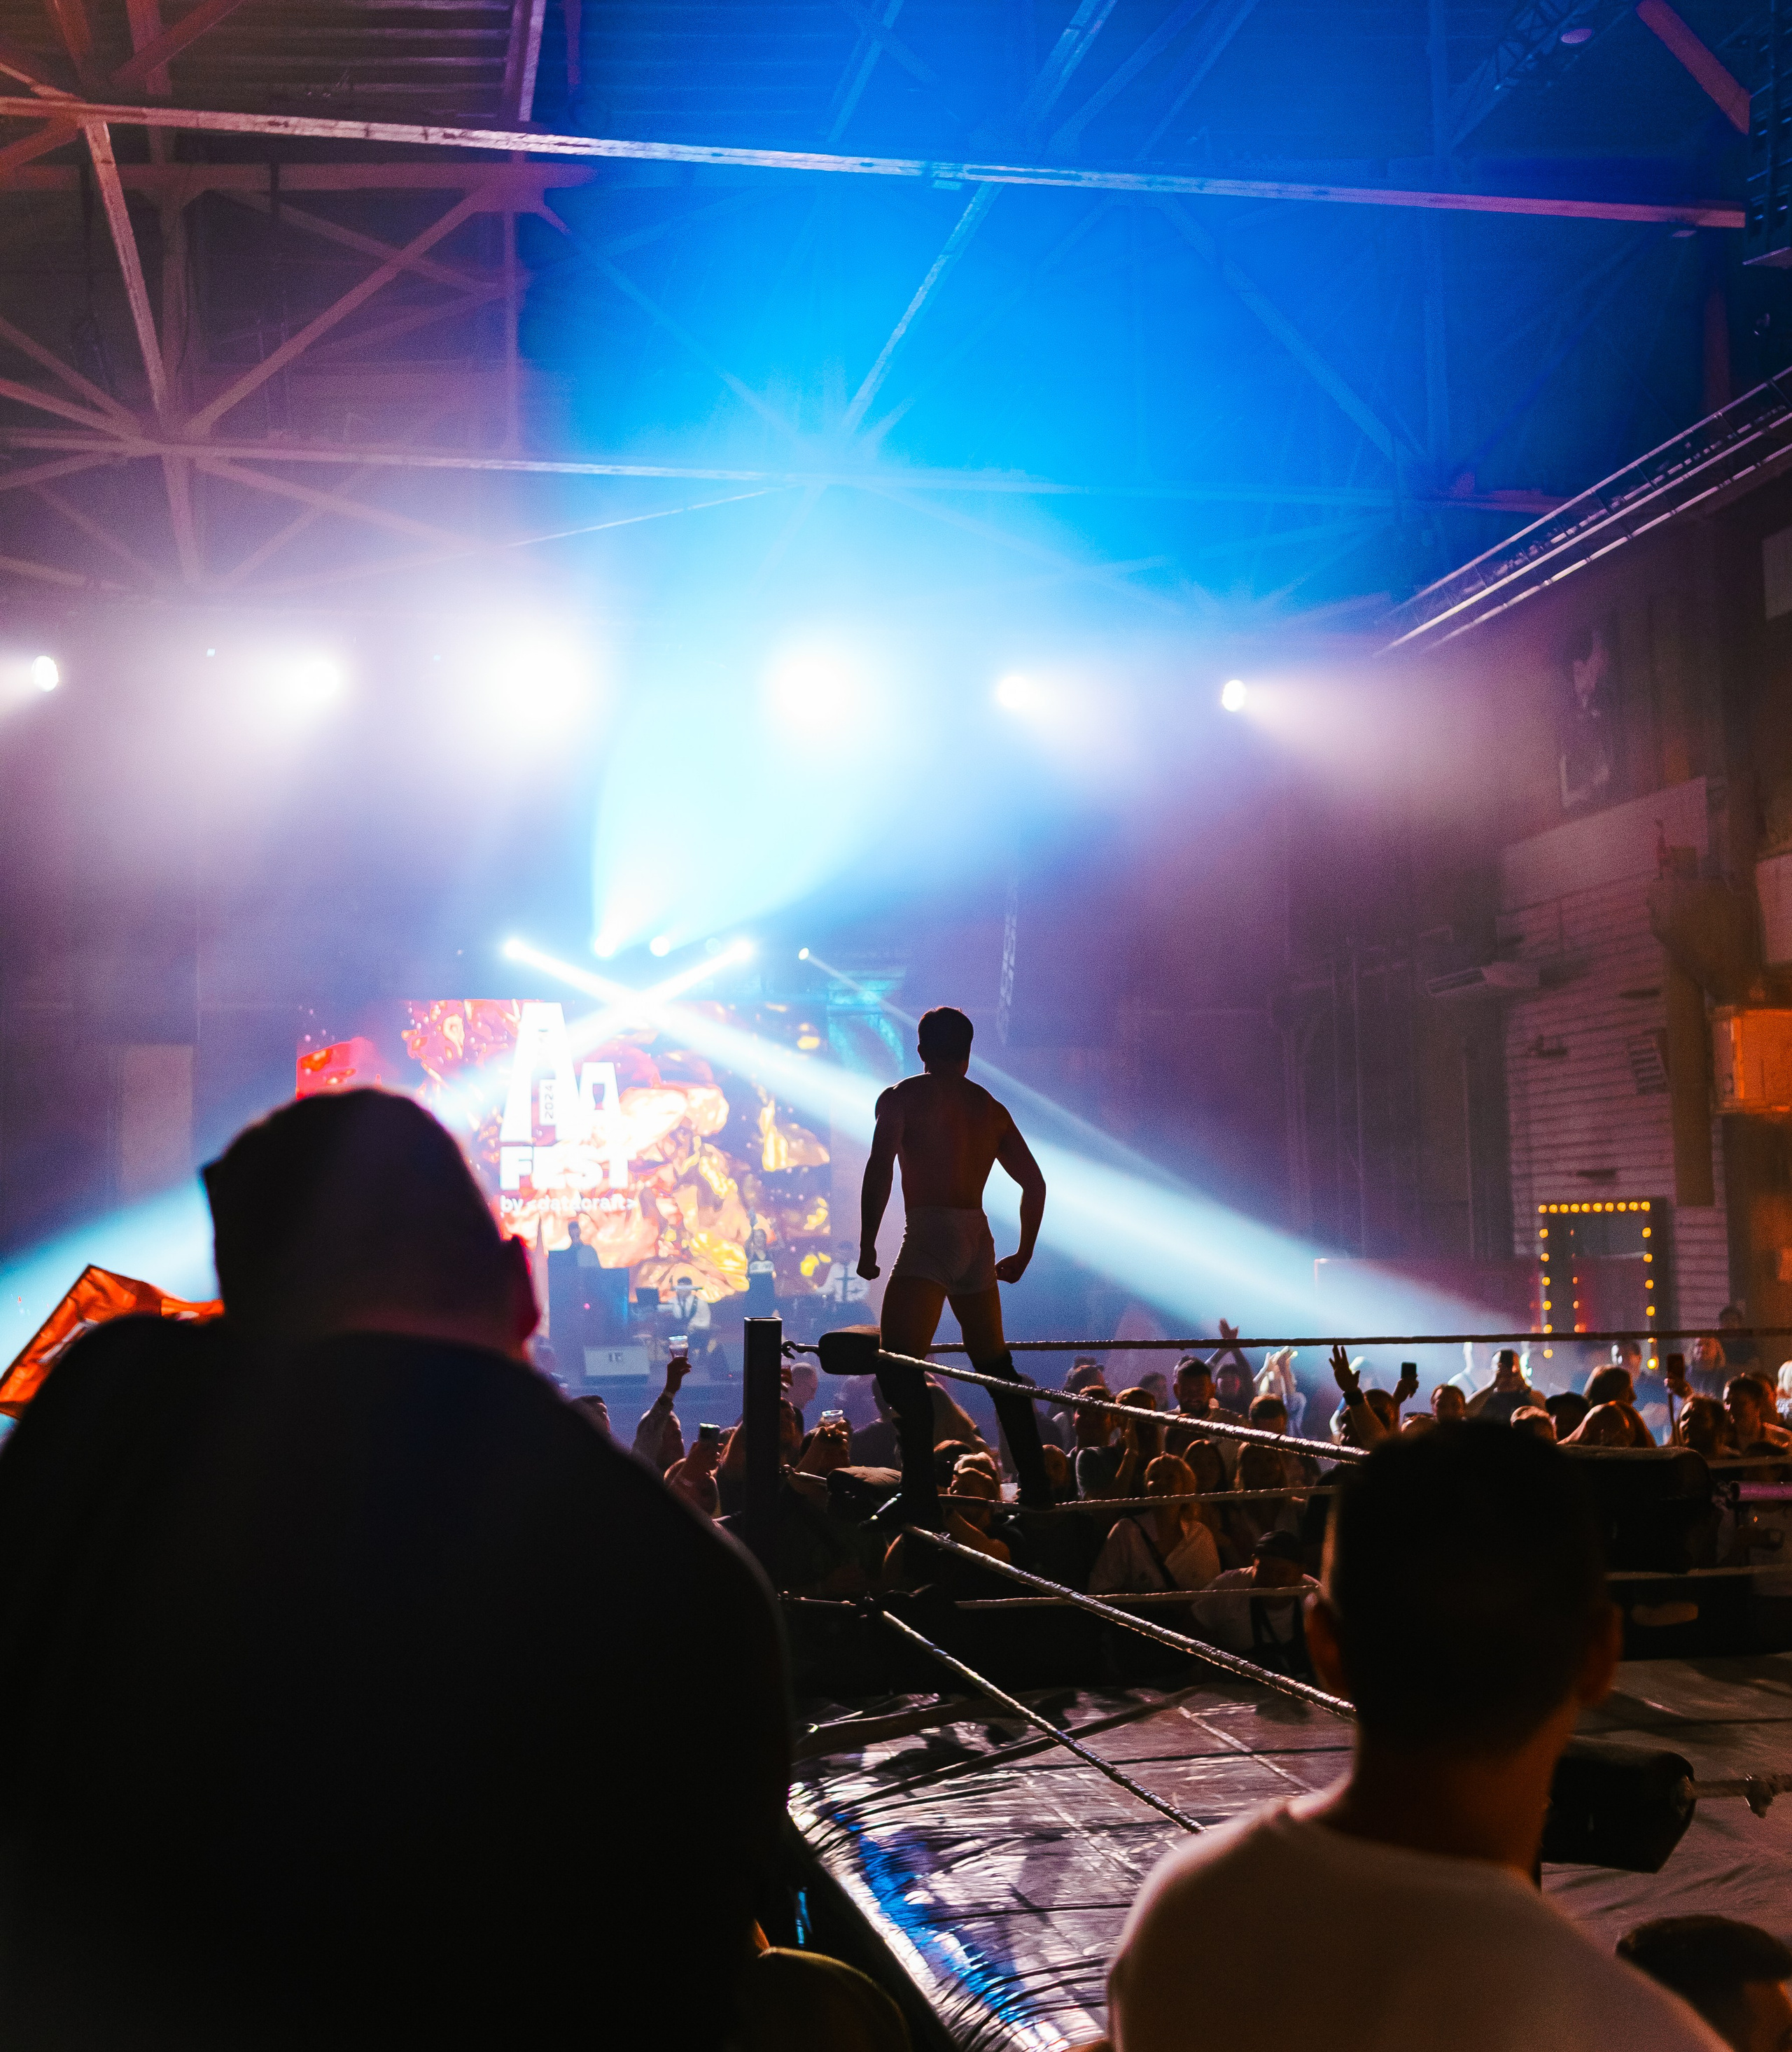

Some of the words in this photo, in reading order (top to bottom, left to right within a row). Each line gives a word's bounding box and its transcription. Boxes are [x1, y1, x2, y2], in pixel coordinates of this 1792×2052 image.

[544, 1084, 554, 1120] 2024
[500, 1146, 636, 1189] FEST
[500, 1195, 524, 1214] by
